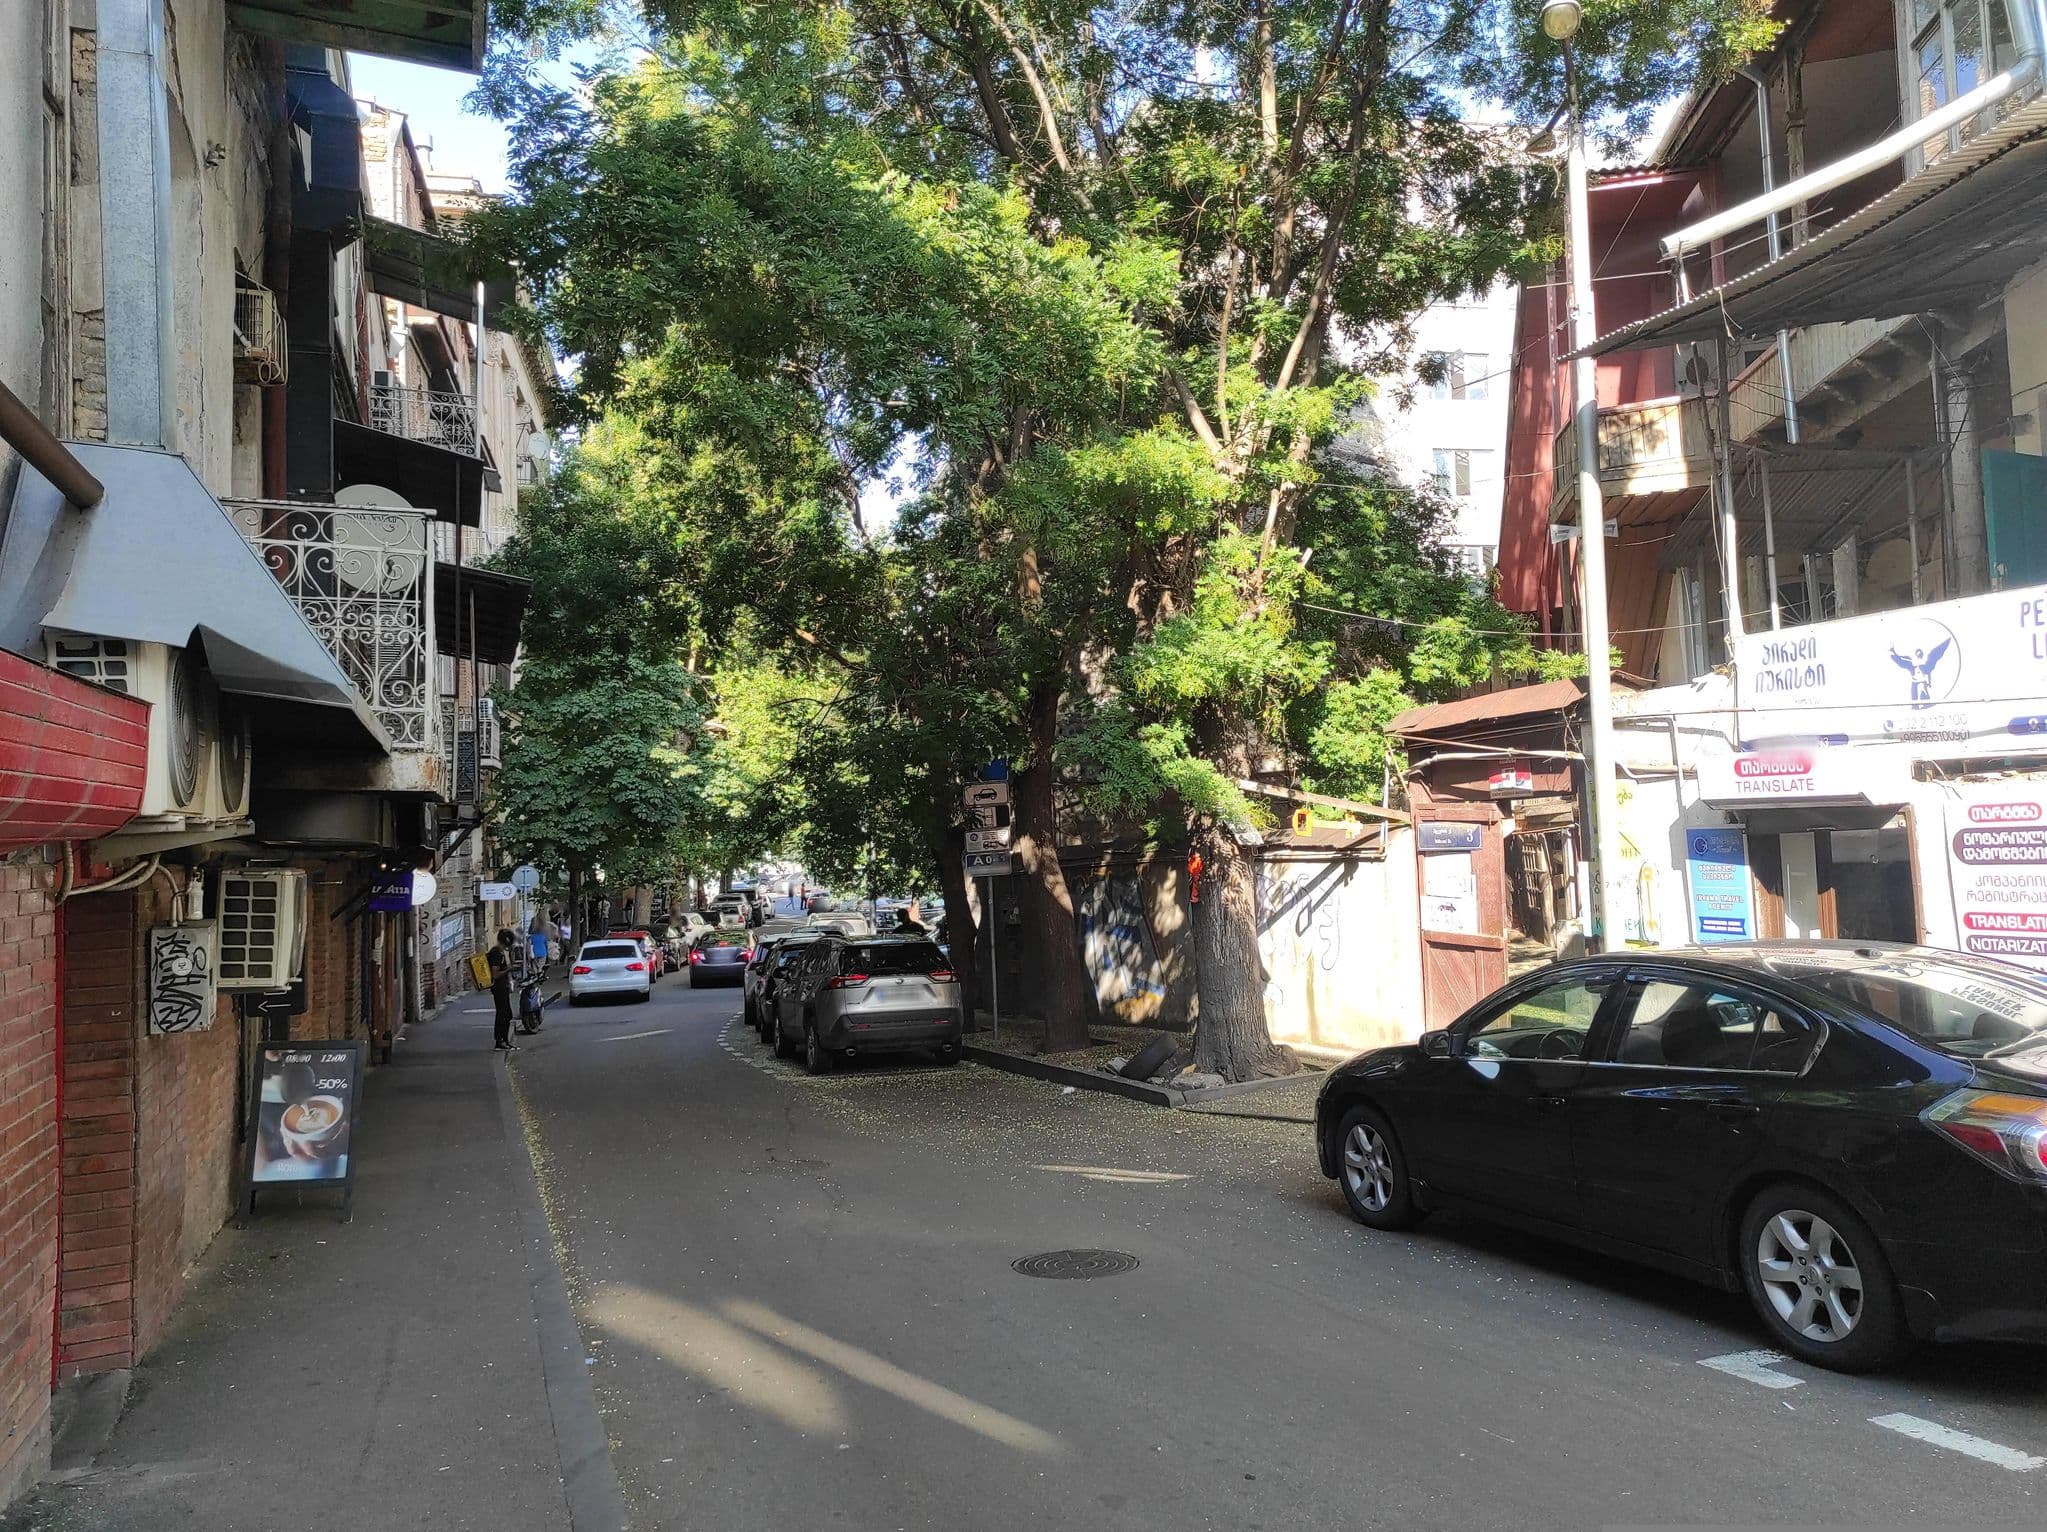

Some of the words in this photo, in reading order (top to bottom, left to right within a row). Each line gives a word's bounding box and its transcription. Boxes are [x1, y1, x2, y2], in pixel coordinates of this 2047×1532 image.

[1762, 637, 1816, 666] პირადი
[2032, 632, 2047, 660] L
[1755, 664, 1826, 693] იურისტი
[1735, 778, 1815, 793] TRANSLATE
[1466, 828, 1474, 843] 3
[1970, 937, 2047, 954] NOTARIZAT
[315, 1078, 348, 1090] -50%
